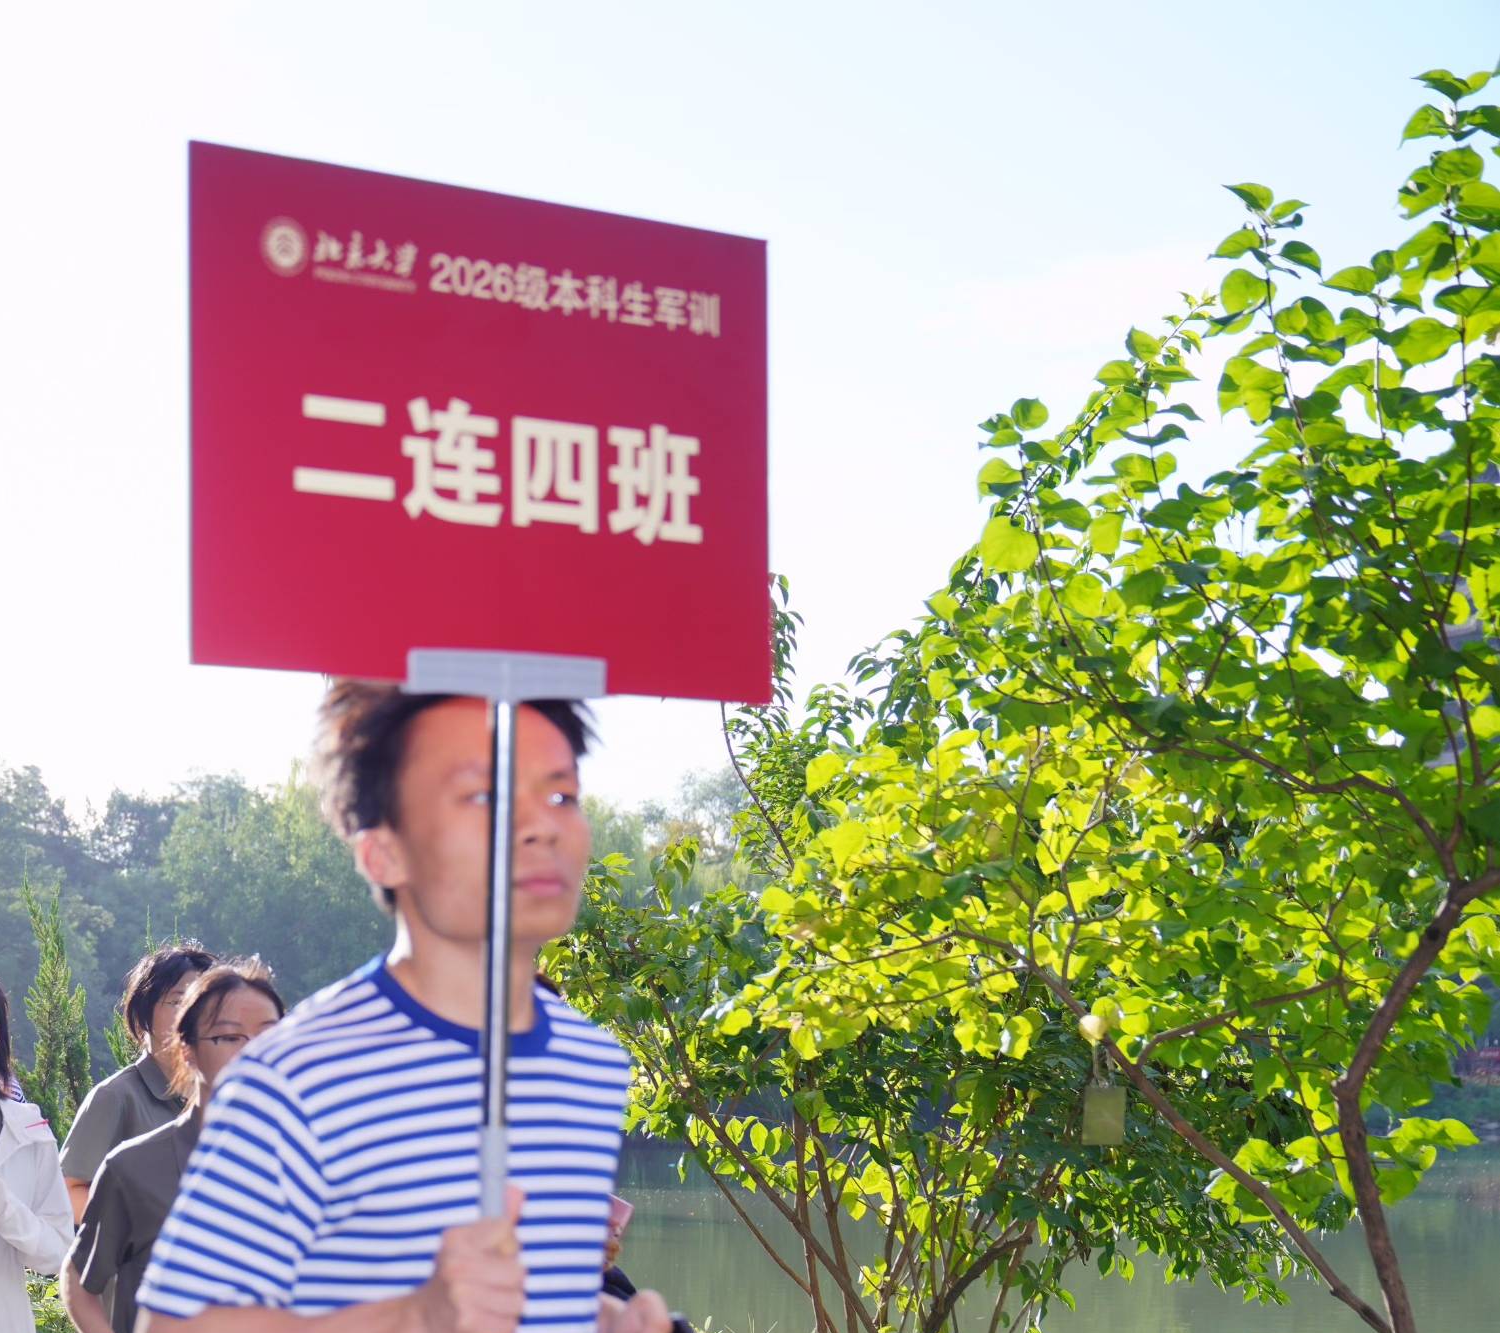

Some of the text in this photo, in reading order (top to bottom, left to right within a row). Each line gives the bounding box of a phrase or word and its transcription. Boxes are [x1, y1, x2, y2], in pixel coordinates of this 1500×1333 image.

[429, 252, 721, 338] 2026级本科生军训
[292, 393, 703, 545] 二连四班
